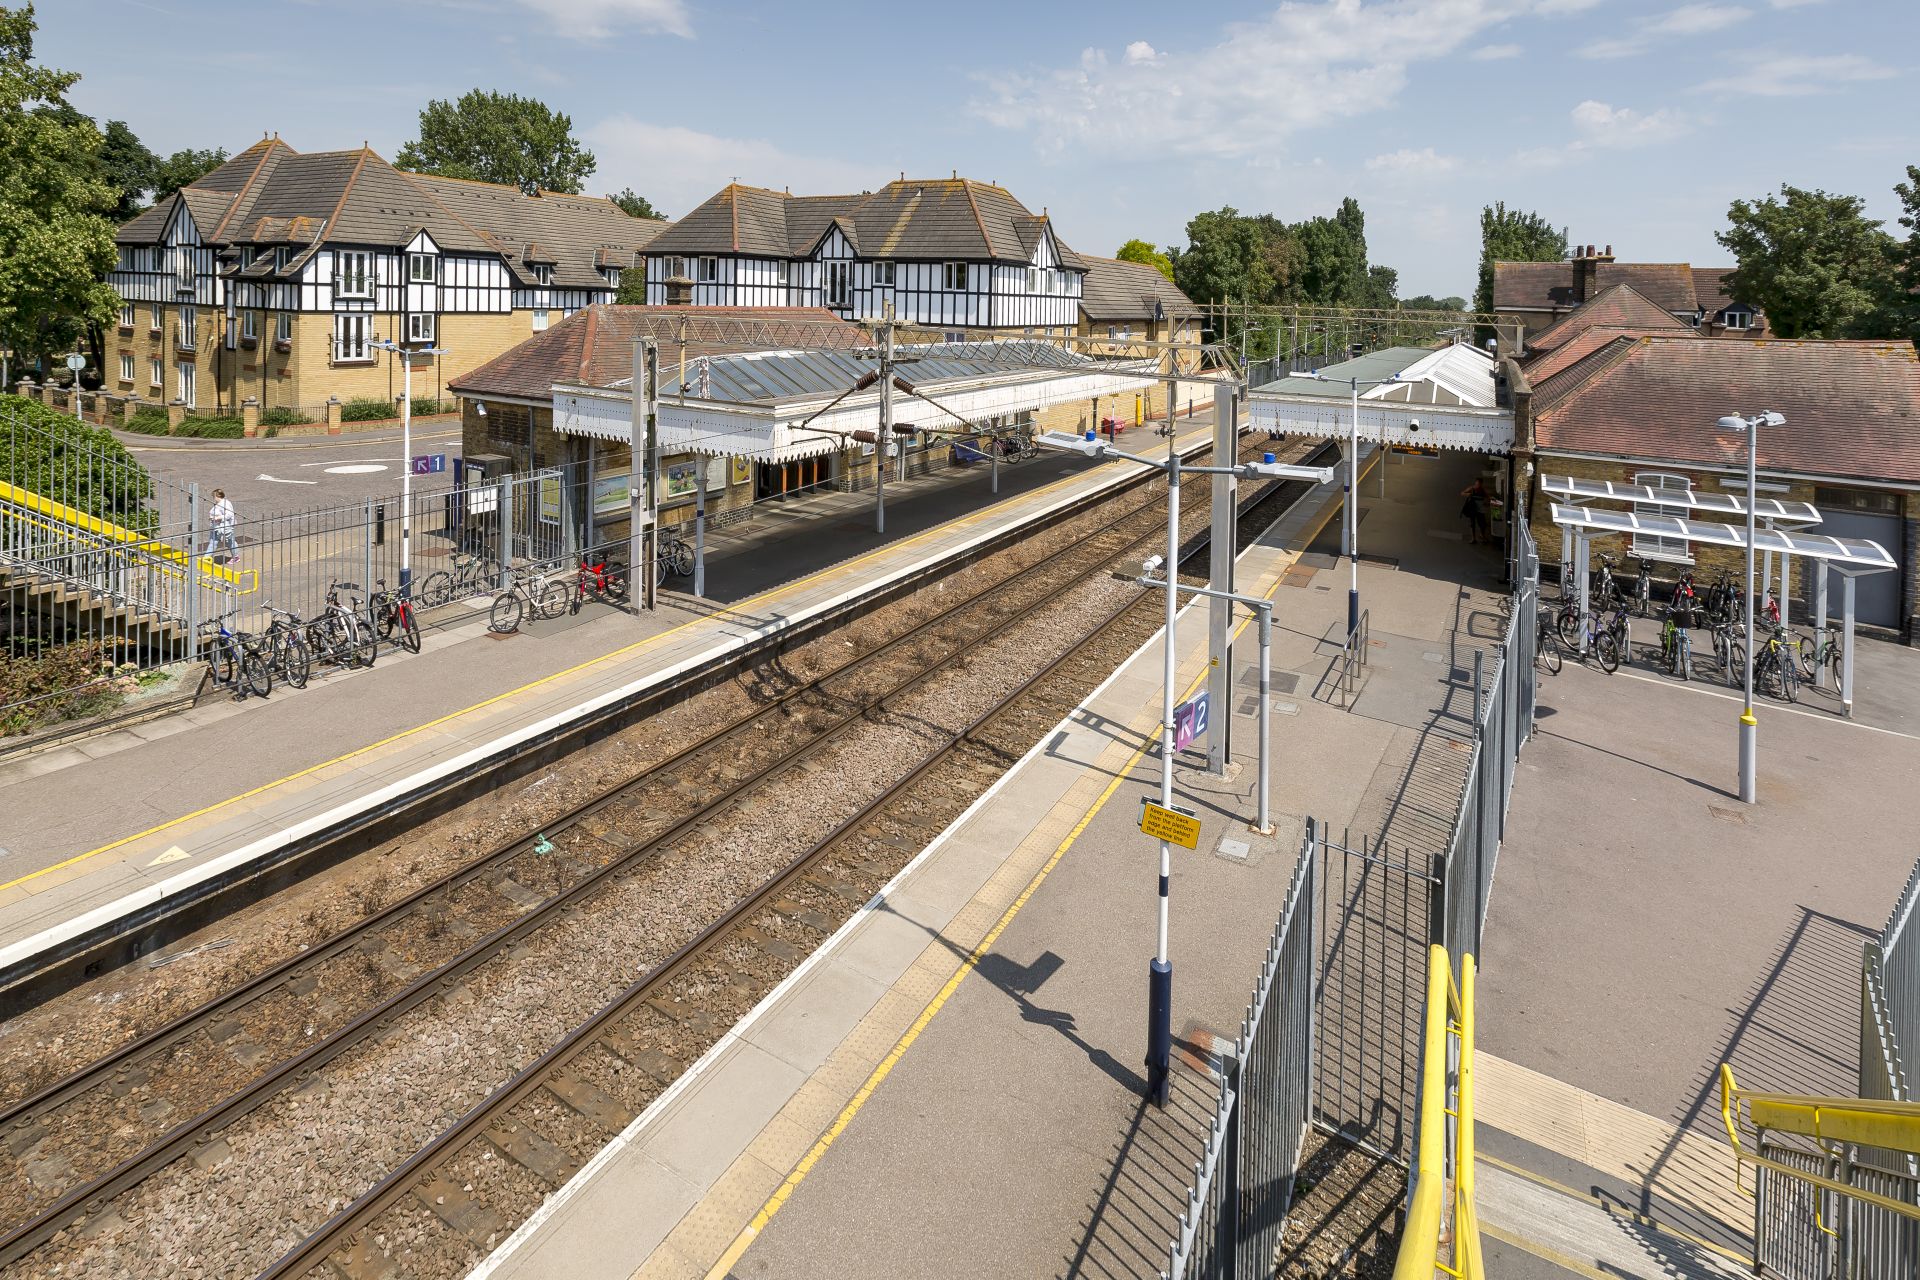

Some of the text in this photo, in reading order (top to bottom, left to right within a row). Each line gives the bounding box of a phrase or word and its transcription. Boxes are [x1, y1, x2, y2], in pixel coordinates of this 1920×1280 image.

[435, 456, 440, 471] 1
[1196, 701, 1206, 733] 2
[1149, 813, 1161, 821] from
[1171, 822, 1194, 833] platform
[1150, 807, 1189, 825] Keep well back
[1147, 820, 1160, 828] edge
[1172, 828, 1191, 839] behind
[1156, 829, 1172, 838] yellow
